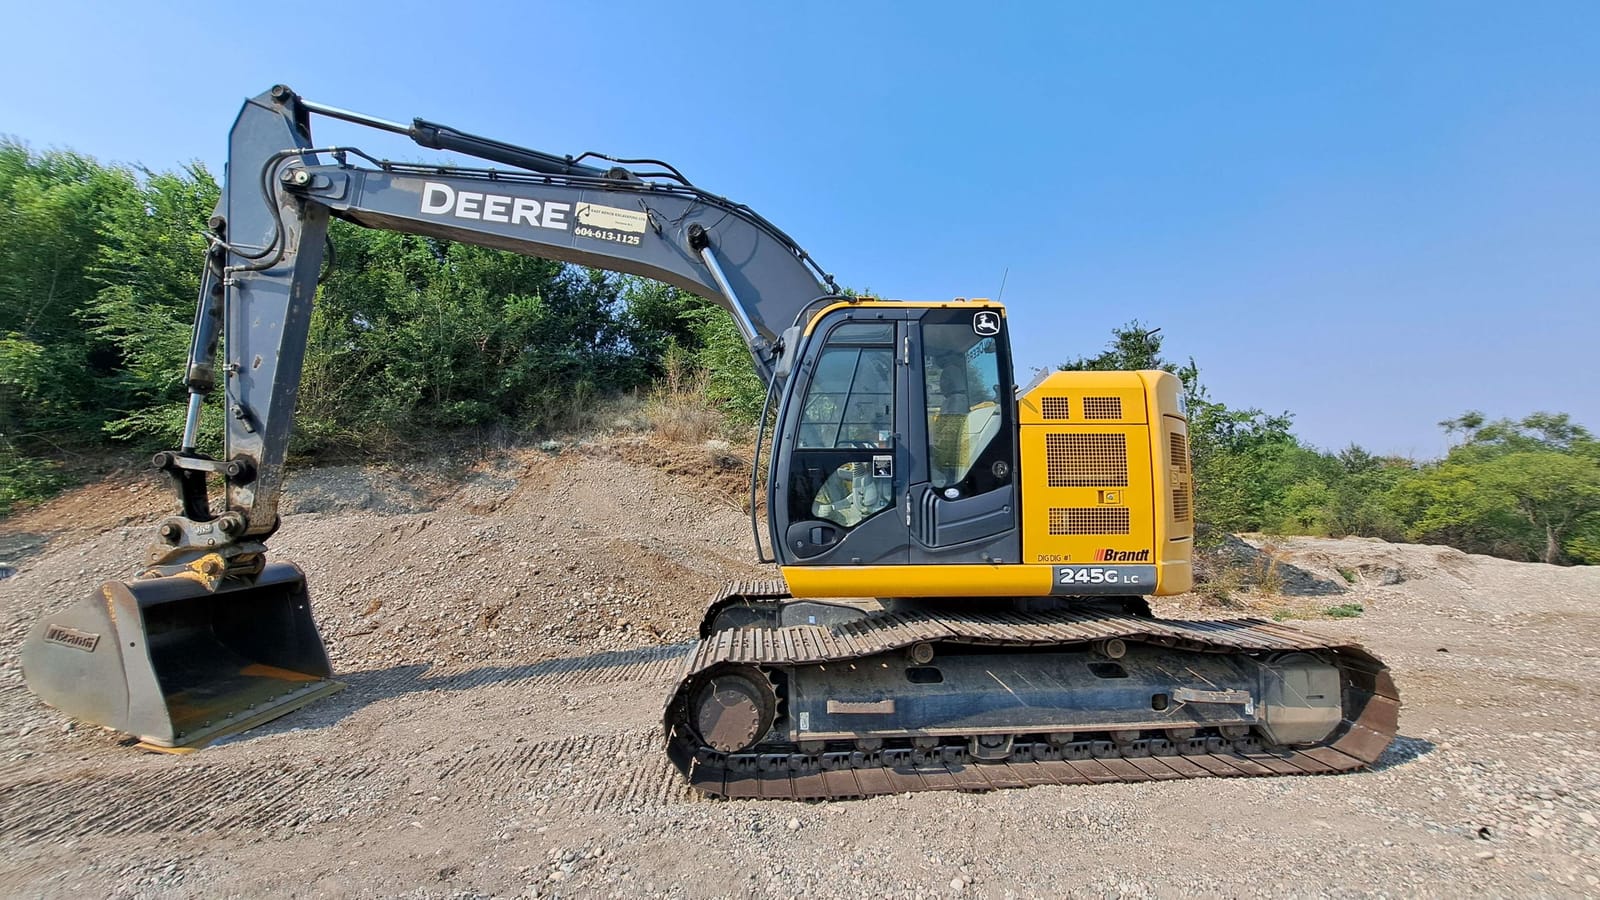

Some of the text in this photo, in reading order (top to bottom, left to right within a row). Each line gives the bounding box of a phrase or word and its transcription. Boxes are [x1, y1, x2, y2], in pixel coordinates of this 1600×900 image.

[420, 181, 571, 231] DEERE
[574, 226, 640, 246] 604-613-1125
[1104, 549, 1150, 562] Brandt
[1059, 567, 1140, 584] 245G LC
